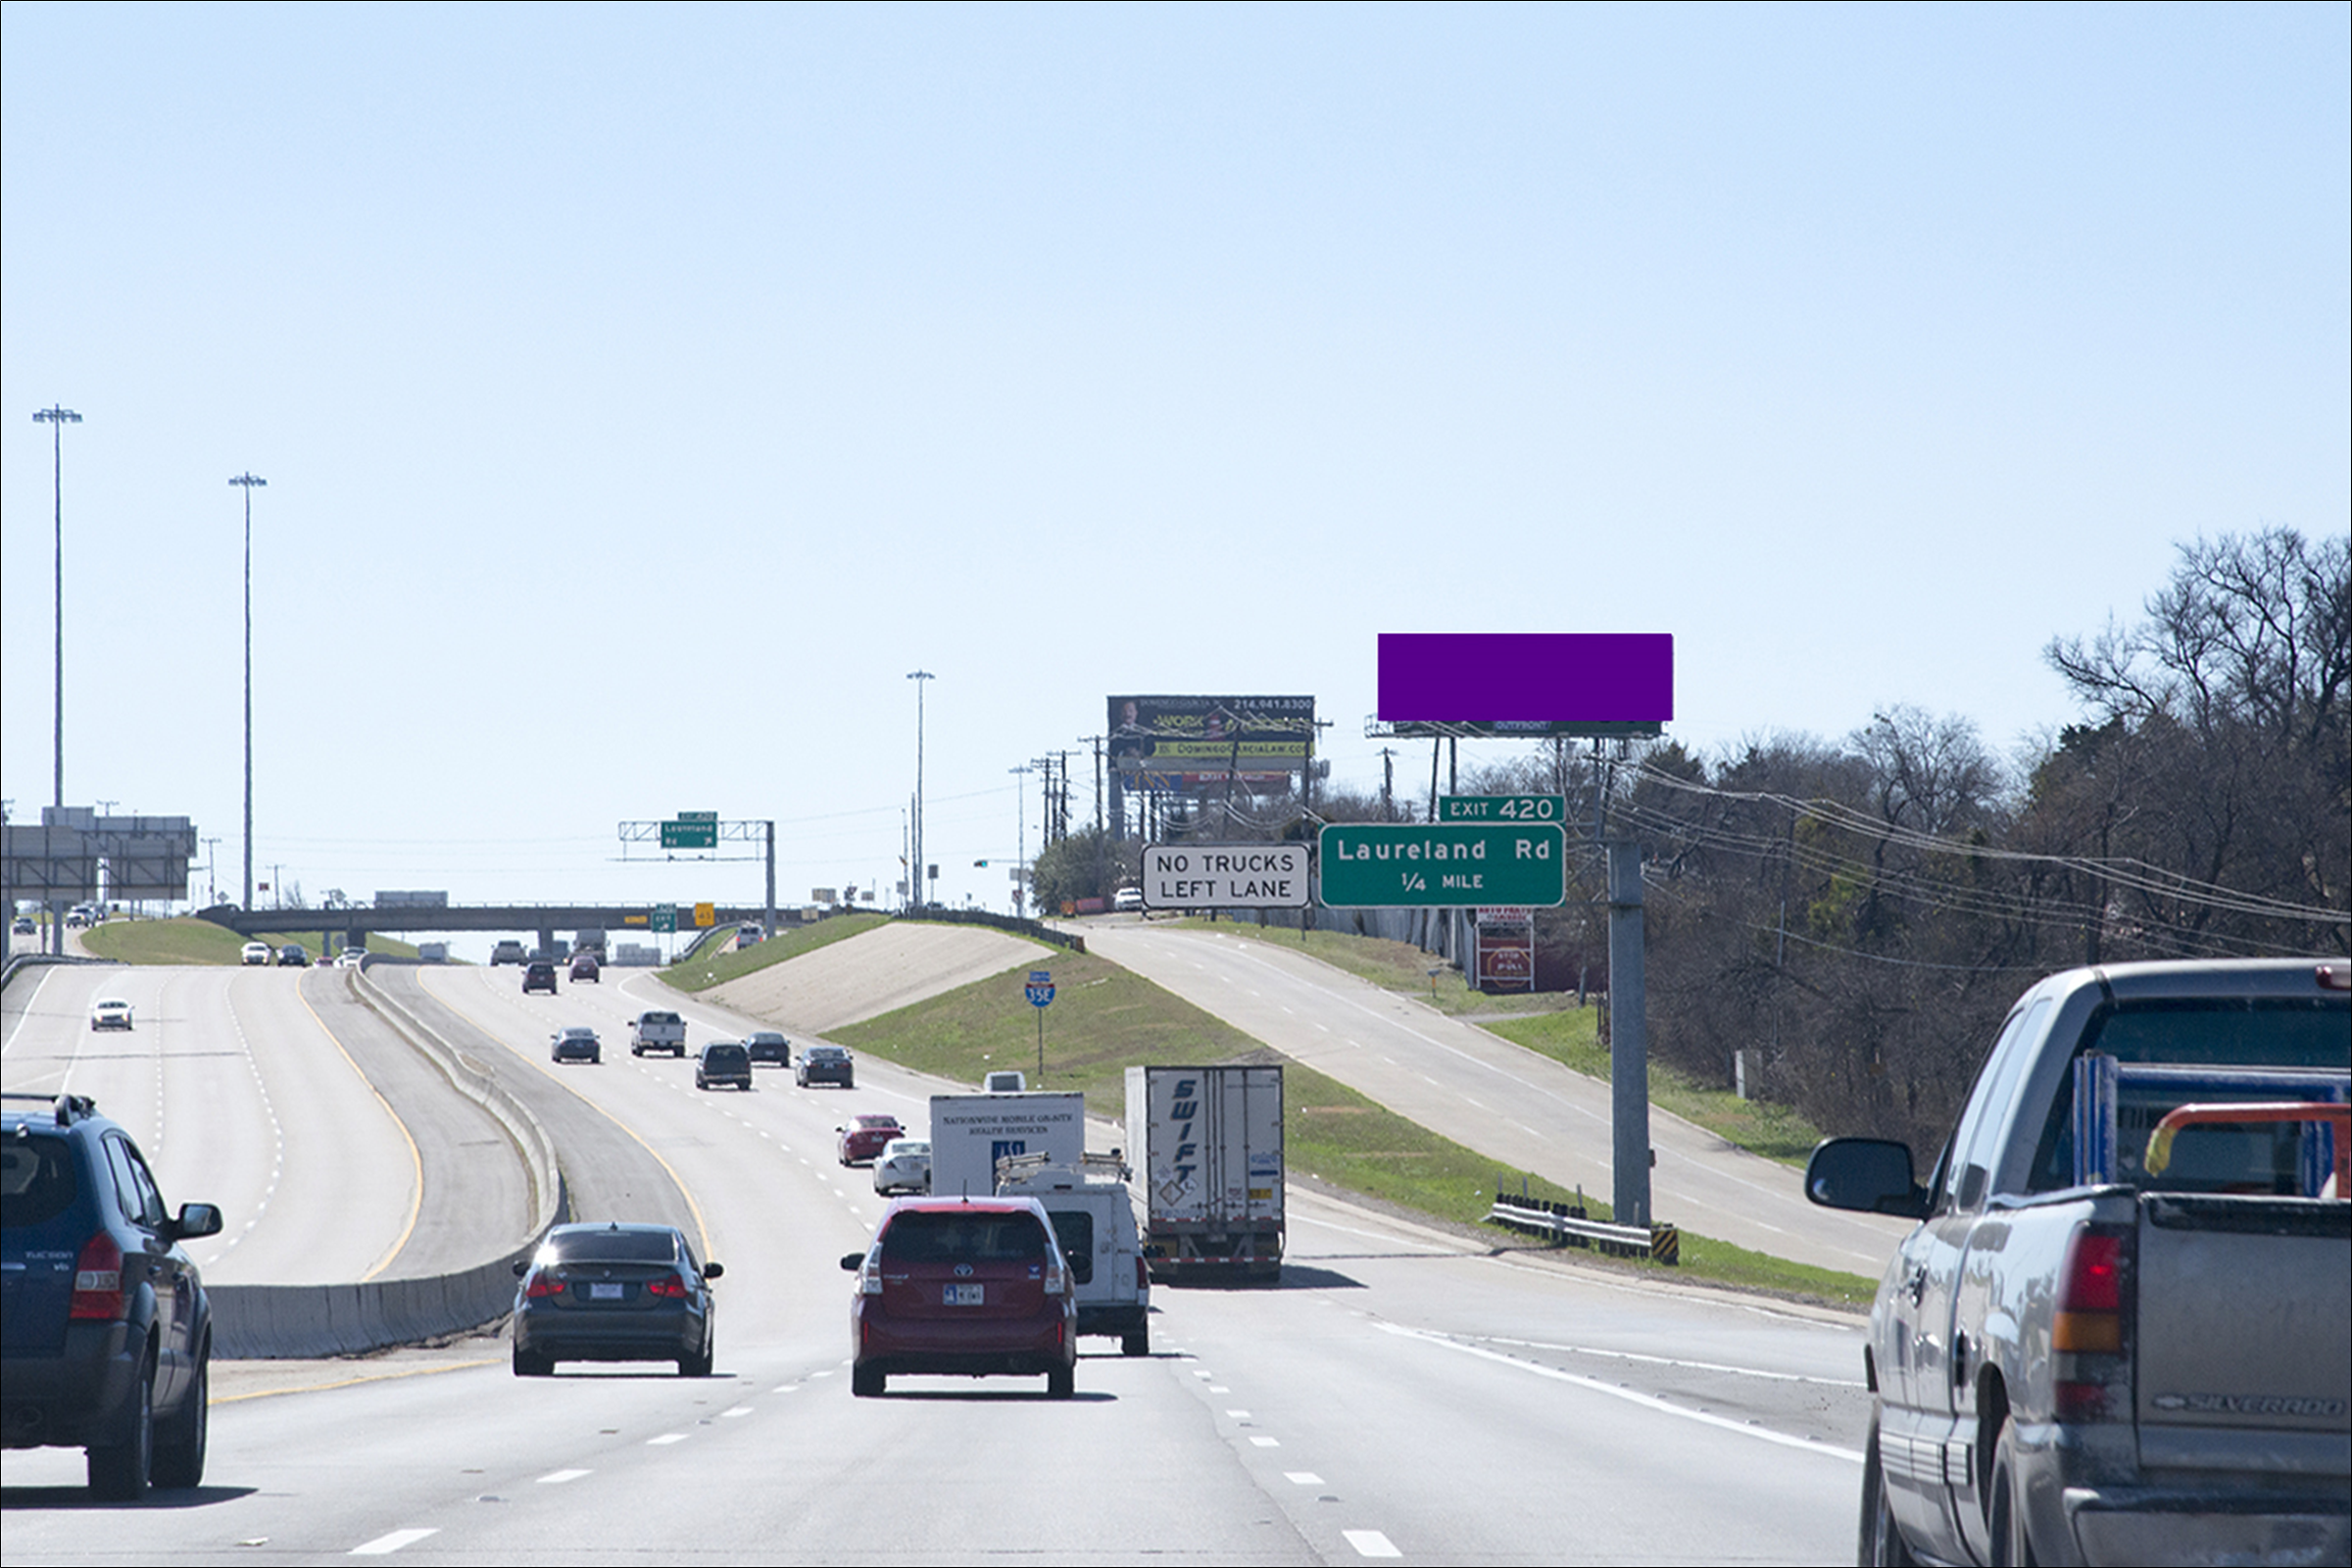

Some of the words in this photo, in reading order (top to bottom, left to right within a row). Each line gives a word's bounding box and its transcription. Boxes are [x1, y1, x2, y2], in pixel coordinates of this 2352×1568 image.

[1234, 699, 1313, 710] 214.941.8300
[1450, 802, 1489, 816] EXIT
[1499, 799, 1553, 819] 420
[1338, 839, 1487, 860] Laureland
[1515, 839, 1550, 859] Rd
[1157, 855, 1189, 872] NO
[1201, 855, 1295, 872] TRUCKS
[1160, 880, 1216, 899] LEFT
[1230, 880, 1293, 899] LANE
[1442, 874, 1484, 889] MILE
[943, 1115, 999, 1125] NATIONWIDE
[1001, 1114, 1035, 1124] MOBILE
[1170, 1079, 1199, 1185] SWIFT
[2185, 1393, 2346, 1416] SILVERADO
